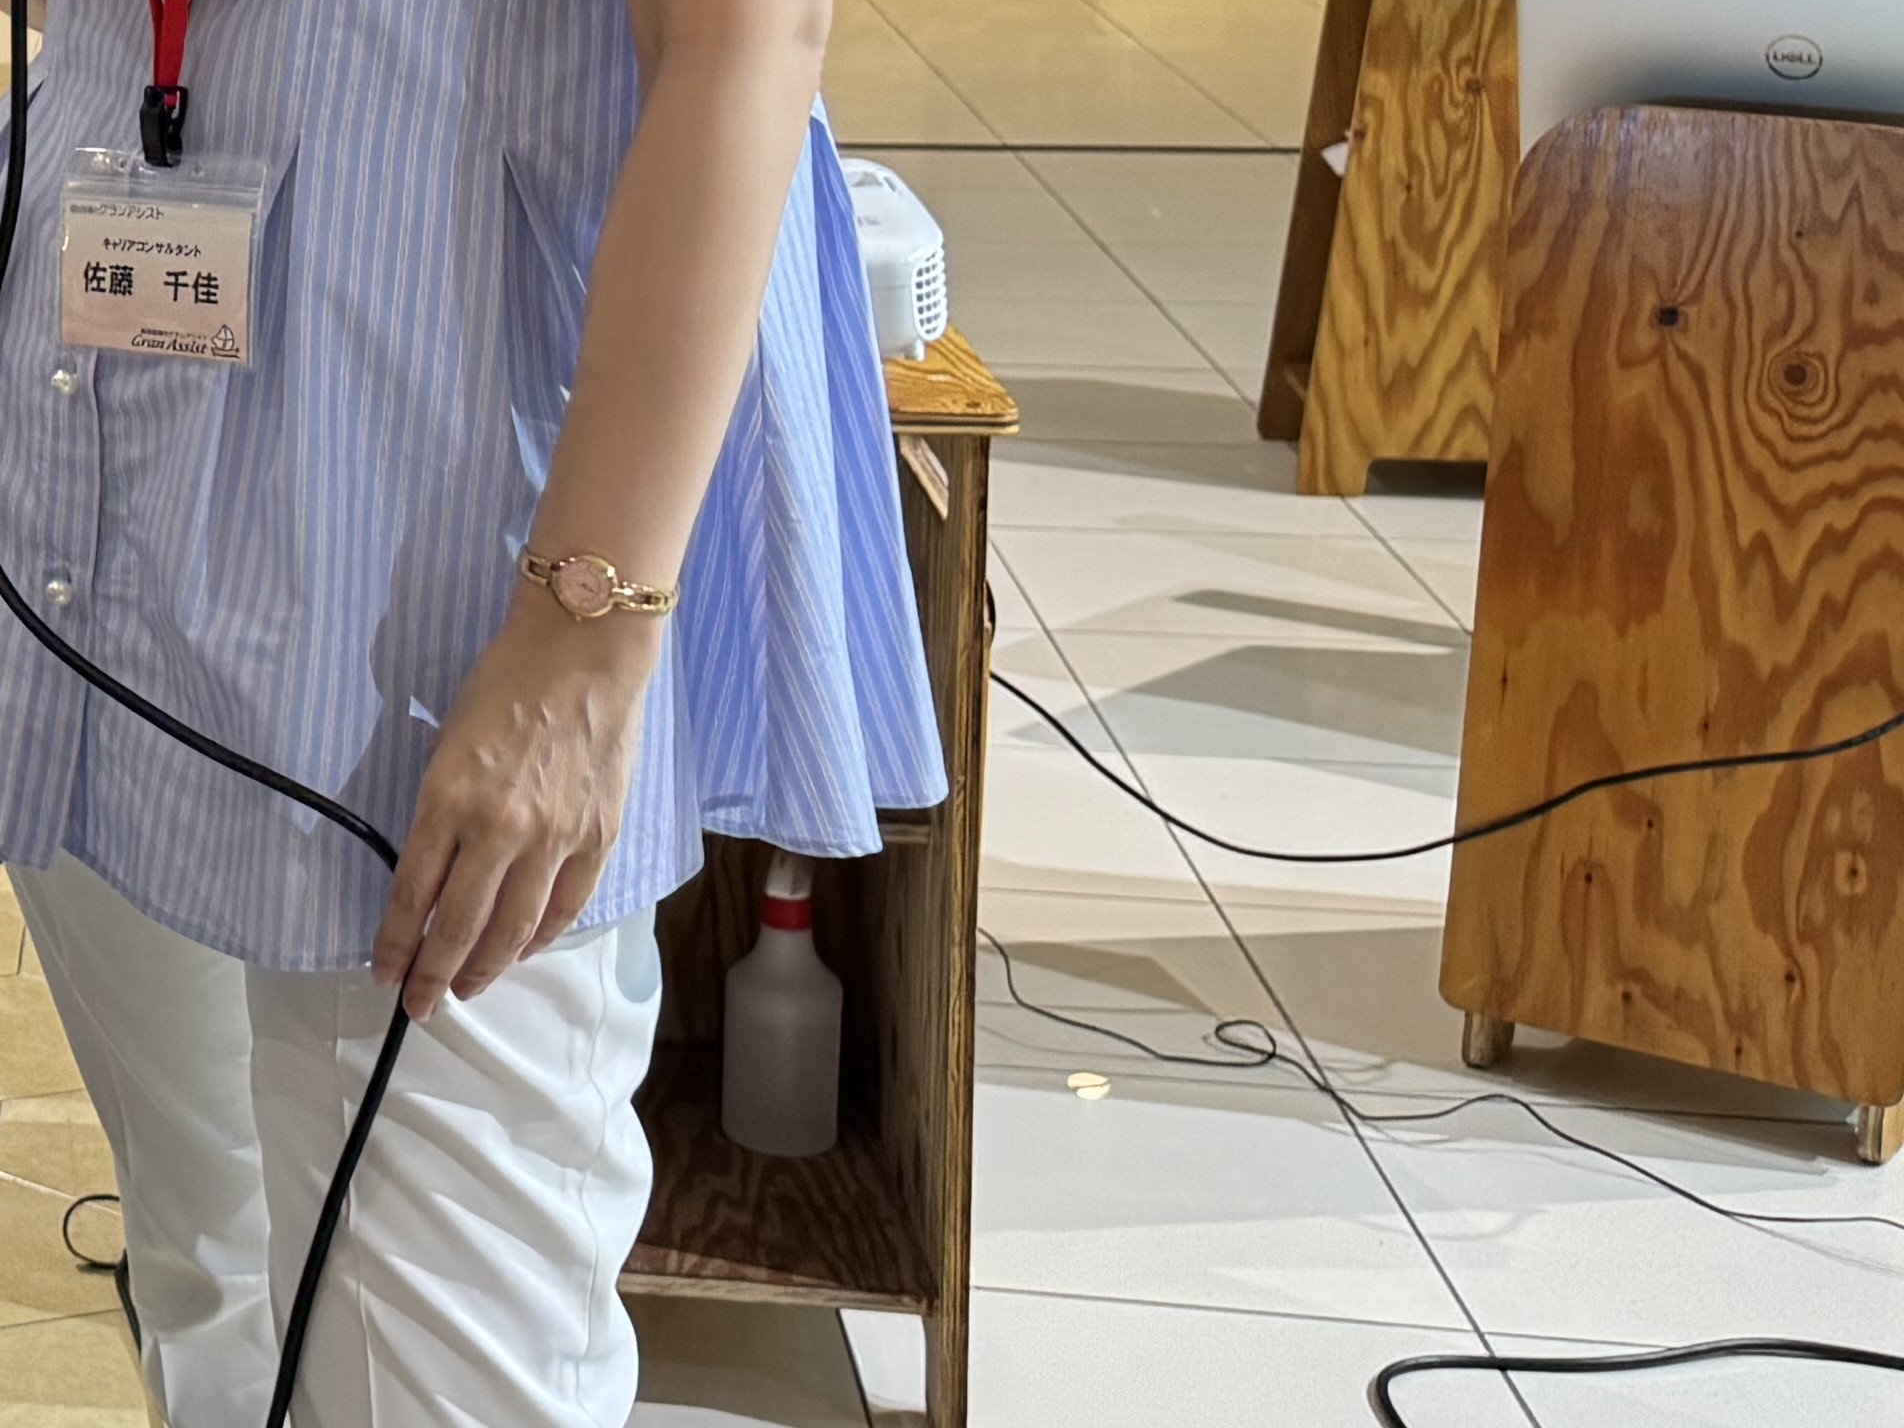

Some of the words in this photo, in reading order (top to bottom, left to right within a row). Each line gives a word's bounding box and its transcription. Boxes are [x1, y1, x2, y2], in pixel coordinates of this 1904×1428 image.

[1773, 51, 1816, 64] DELL
[103, 237, 201, 257] キャリアコンサルタント
[84, 261, 134, 296] 佐藤
[163, 270, 219, 305] 千佳
